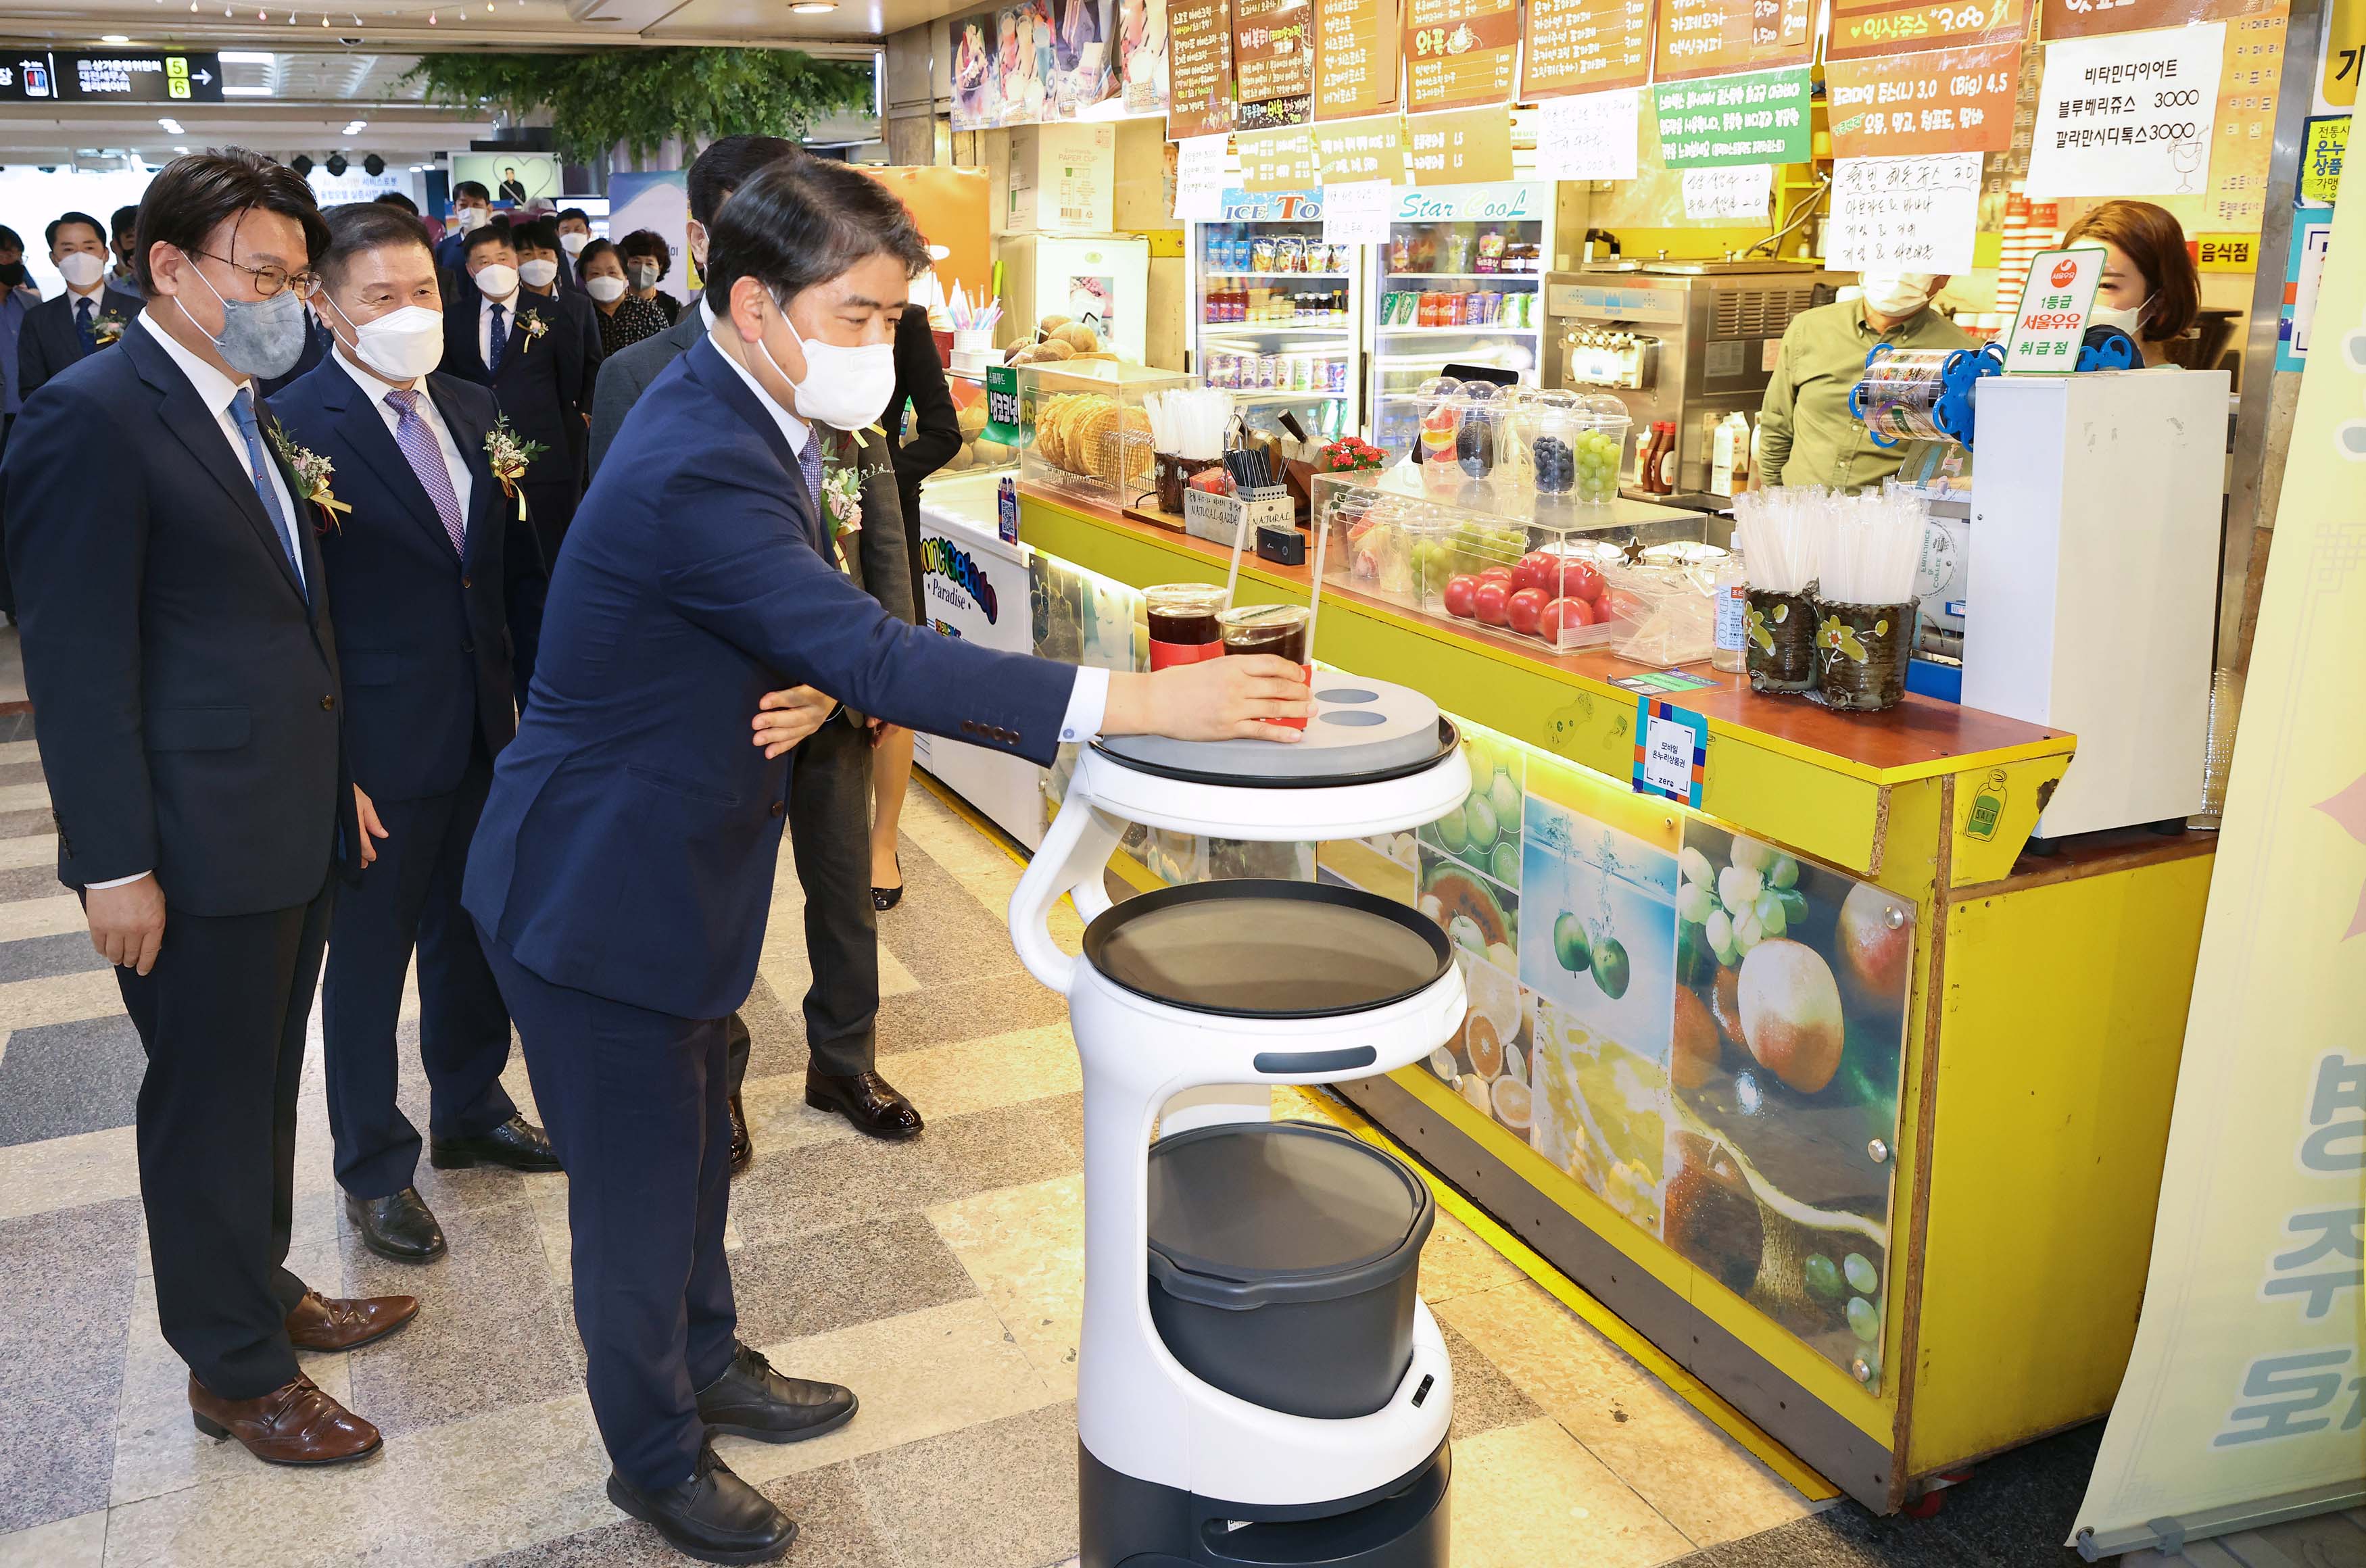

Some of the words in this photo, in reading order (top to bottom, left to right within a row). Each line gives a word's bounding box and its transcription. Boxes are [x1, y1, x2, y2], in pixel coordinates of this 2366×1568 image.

[1566, 11, 1591, 26] 프라페
[1670, 7, 1728, 32] 카페모카
[1864, 14, 1928, 40] 인삼쥬스
[1416, 27, 1445, 56] 와플
[1570, 27, 1597, 42] 프라페
[1572, 43, 1600, 58] 프라페
[1670, 33, 1722, 55] 맥심커피
[172, 61, 183, 74] 5
[1580, 57, 1607, 73] 프라페
[2085, 59, 2177, 84] 비타민다이어트
[174, 80, 185, 95] 6
[1833, 84, 1875, 106] 프리미엄
[1917, 79, 1937, 99] 3.0
[1950, 74, 1983, 97] (Big)
[1986, 72, 2008, 93] 4.5
[2058, 99, 2135, 119] 블루베리쥬스
[2154, 89, 2199, 109] 3000
[2315, 140, 2345, 157] 온누
[1954, 166, 1973, 179] 3.0
[2312, 158, 2342, 176] 상품
[2317, 178, 2338, 191] 가맹
[1225, 203, 1268, 222] ICE
[1399, 193, 1453, 219] Star
[1845, 198, 1887, 220] 아보카도
[1904, 196, 1934, 216] 바나나
[2202, 243, 2249, 262] 음식점
[2041, 295, 2073, 310] 1등급
[2021, 313, 2081, 330] 서울우유
[2019, 341, 2069, 356] 취급점
[989, 372, 1006, 385] 슈퍼푸드
[990, 391, 1018, 426] 생코코넛
[1253, 512, 1291, 525] NATURAL
[932, 579, 965, 610] Paradise
[1661, 741, 1679, 754] 모바일
[1652, 750, 1685, 768] 온누리상품권
[1659, 777, 1674, 787] zero
[1975, 808, 1995, 824] SALT
